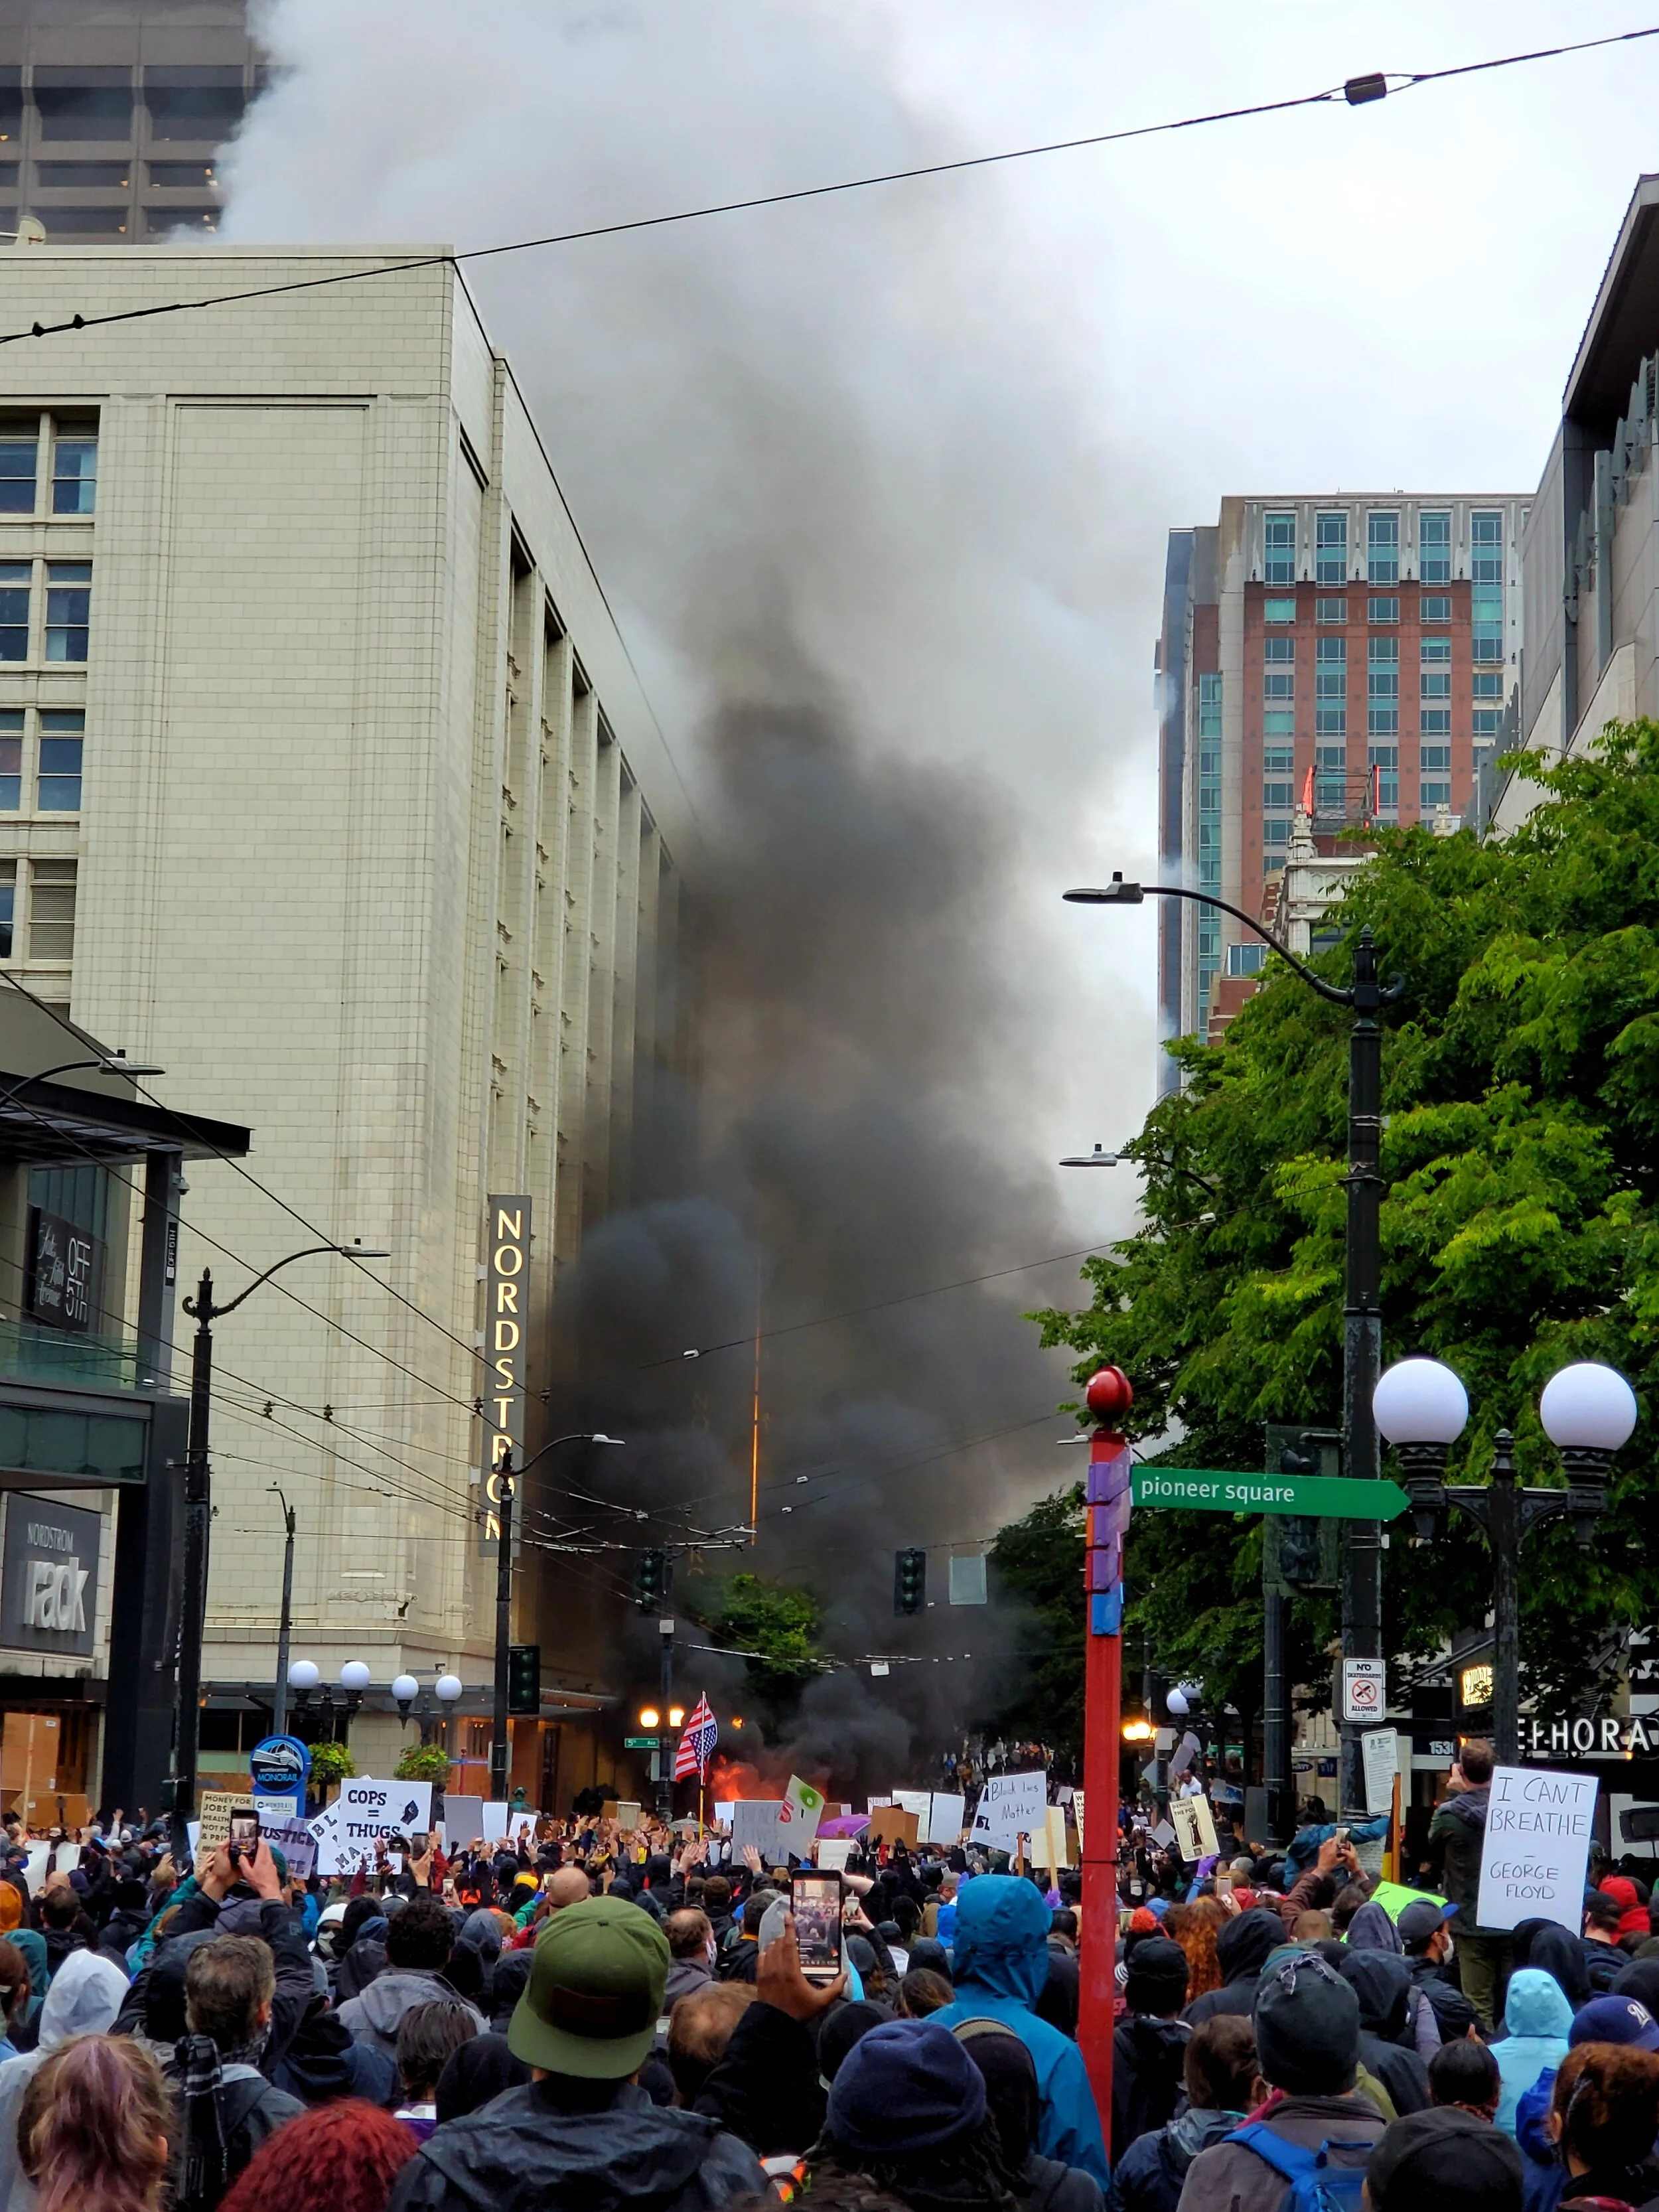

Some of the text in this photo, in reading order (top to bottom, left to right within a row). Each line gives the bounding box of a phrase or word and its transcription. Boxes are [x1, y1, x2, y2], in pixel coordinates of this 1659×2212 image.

[68, 1237, 92, 1281] OFF
[66, 1277, 90, 1323] 5TH
[1141, 1477, 1295, 1505] pioneer square
[27, 1522, 74, 1553] NORDSTROM
[24, 1556, 90, 1632] rack
[257, 1773, 298, 1782] MONORAIL
[348, 1790, 387, 1806] COPS
[1497, 1777, 1589, 1804] I CANT
[204, 1804, 227, 1812] JOBS
[1001, 1803, 1036, 1820] Matter
[346, 1823, 400, 1839] THUGS
[1490, 1808, 1588, 1836] BREATHE
[1490, 1860, 1559, 1881] GEORGE
[1506, 1883, 1555, 1899] FLOYD
